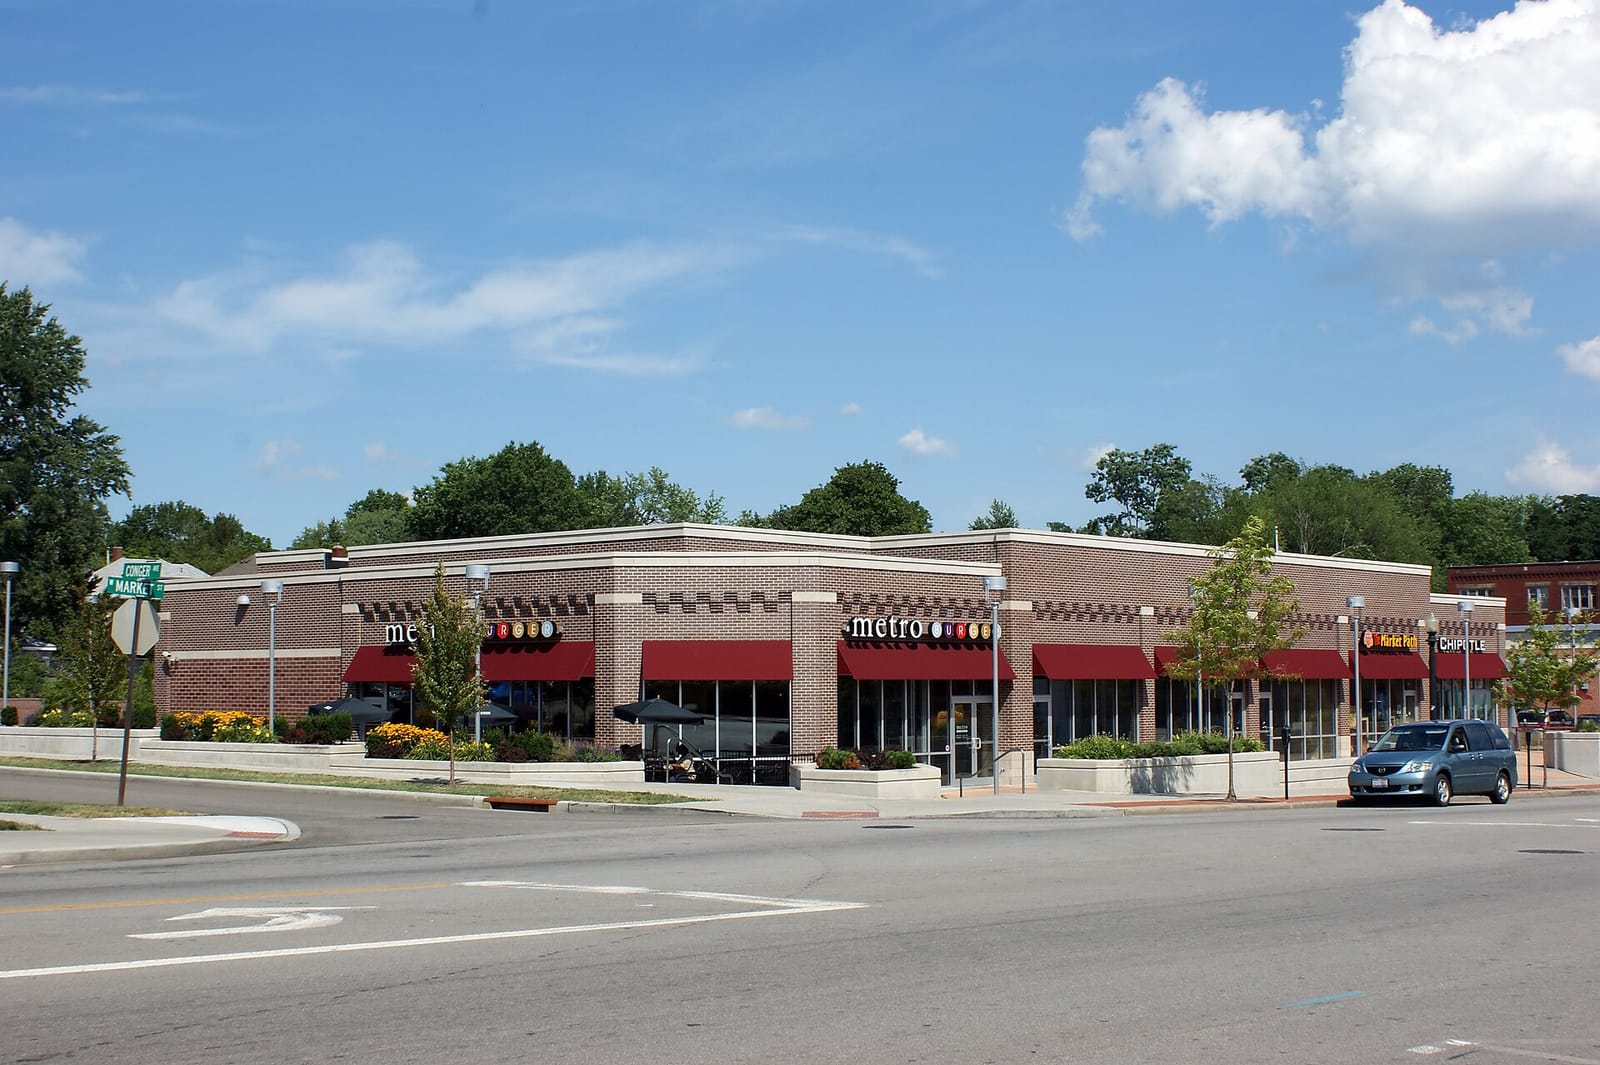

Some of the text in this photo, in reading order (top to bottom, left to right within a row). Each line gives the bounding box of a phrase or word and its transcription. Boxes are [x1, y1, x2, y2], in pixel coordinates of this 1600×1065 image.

[125, 564, 151, 577] CONGER
[115, 579, 154, 596] MARKET
[851, 616, 922, 639] metro
